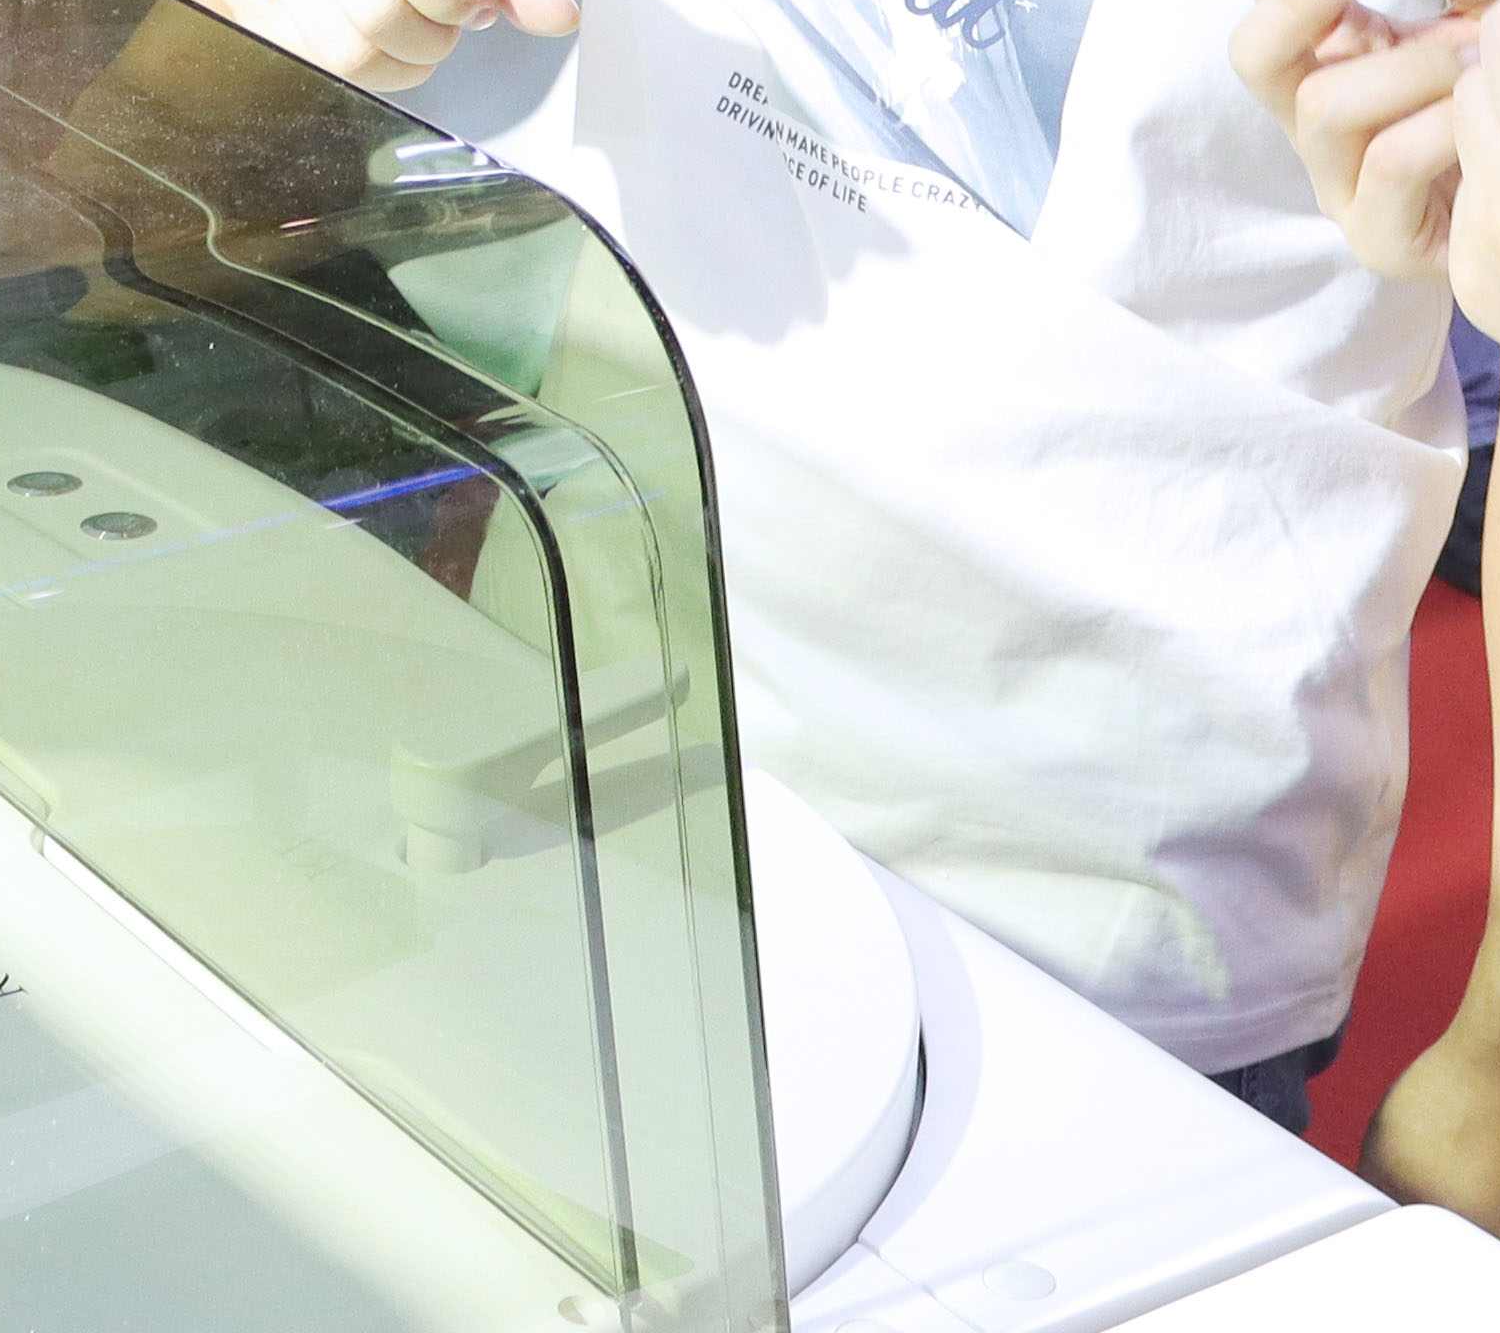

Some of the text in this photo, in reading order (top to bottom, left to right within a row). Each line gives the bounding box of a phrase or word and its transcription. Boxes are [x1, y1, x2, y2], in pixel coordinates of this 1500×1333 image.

[787, 132, 829, 164] MAKE
[831, 152, 904, 195] PEOPLE
[808, 169, 829, 190] OF
[833, 180, 867, 213] LIFE
